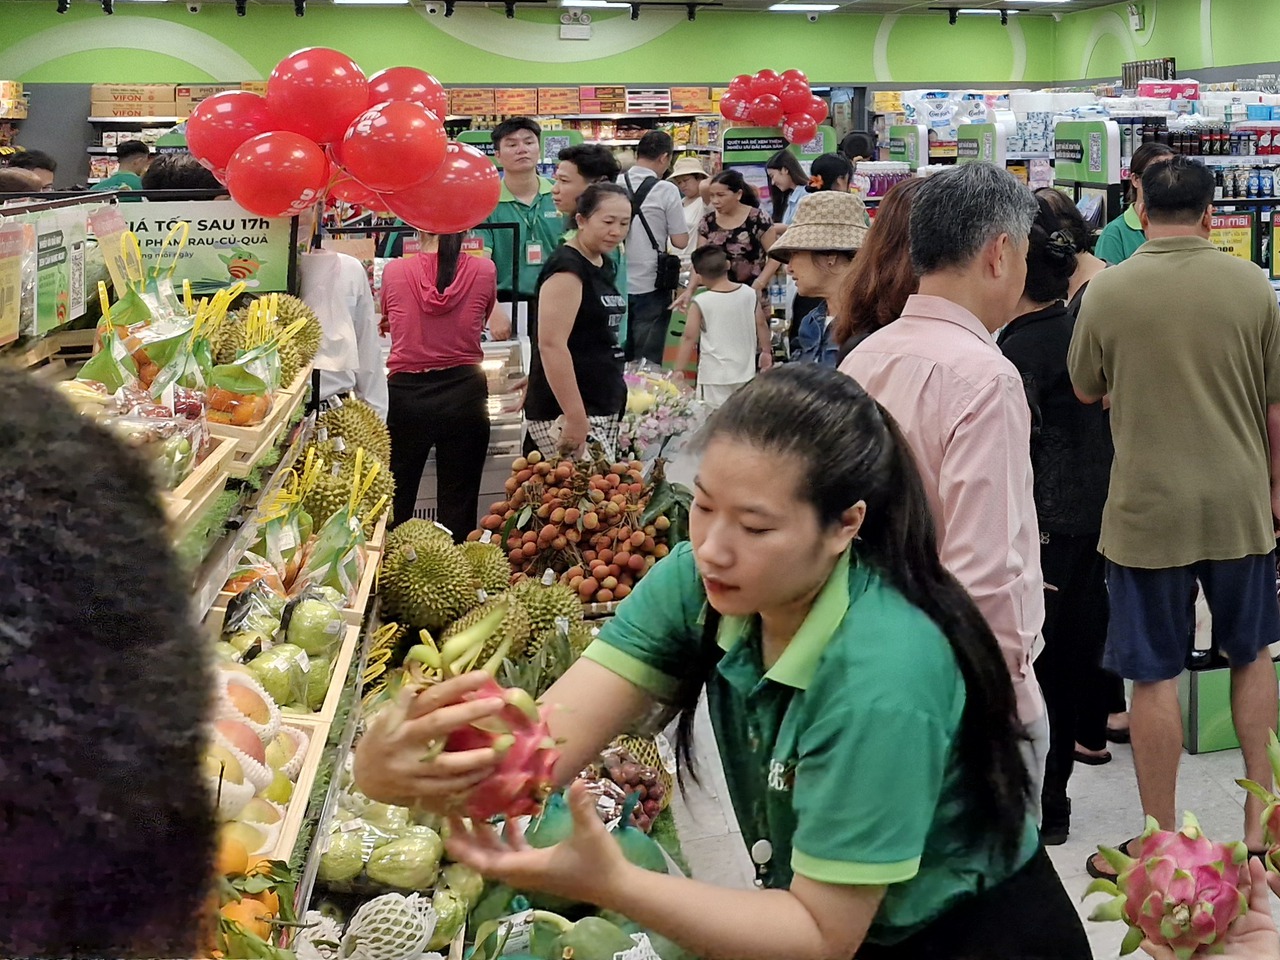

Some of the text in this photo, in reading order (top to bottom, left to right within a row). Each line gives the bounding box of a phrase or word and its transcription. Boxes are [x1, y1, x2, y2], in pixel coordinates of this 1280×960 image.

[125, 218, 149, 232] IÁ
[197, 219, 235, 231] SAU
[241, 218, 270, 230] 17h
[145, 238, 182, 247] PHM
[188, 234, 268, 246] RAU-CỦ-QUẢ
